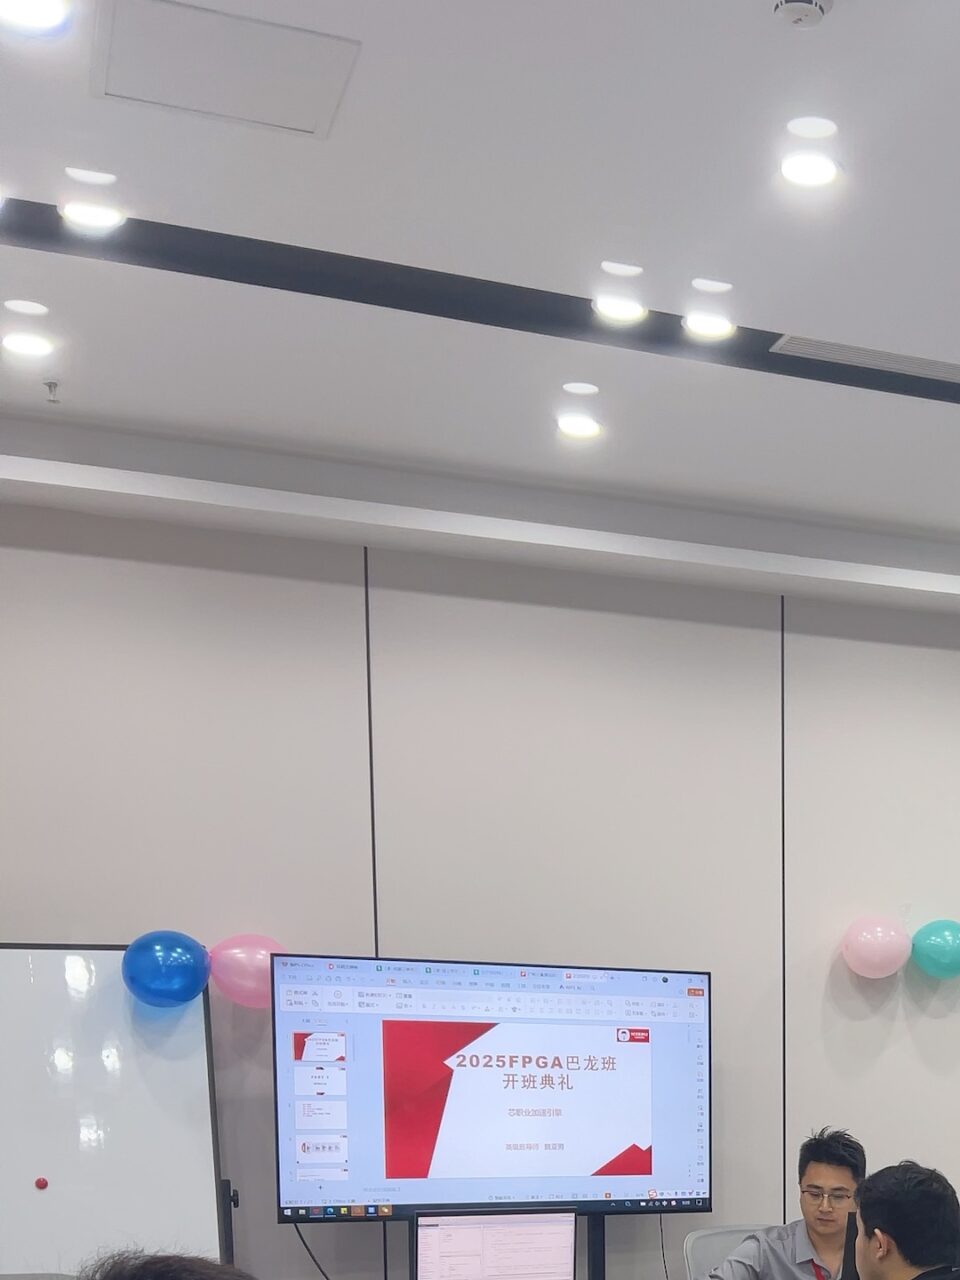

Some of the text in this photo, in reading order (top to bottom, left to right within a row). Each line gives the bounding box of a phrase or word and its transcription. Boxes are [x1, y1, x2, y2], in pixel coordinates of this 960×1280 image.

[455, 1054, 617, 1071] 2025FPGA巴龙班
[502, 1073, 574, 1090] 开班典礼
